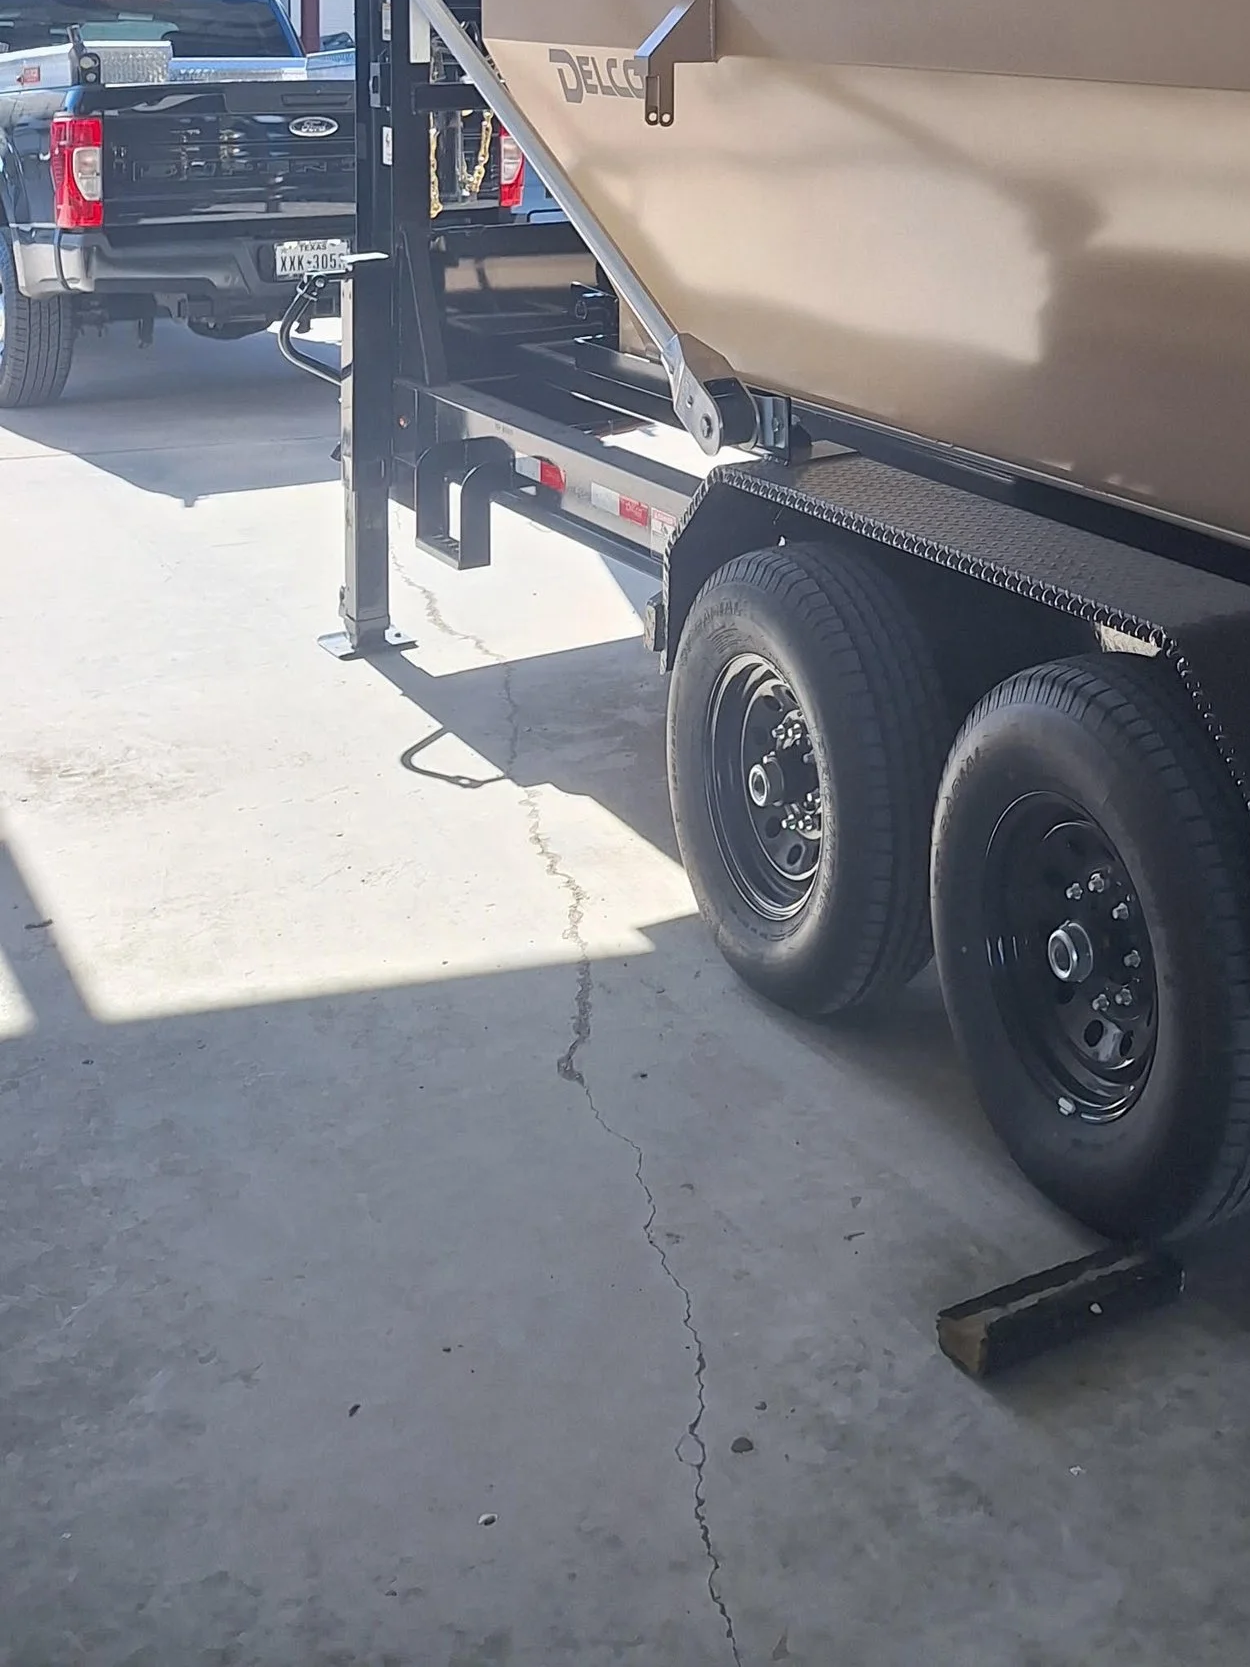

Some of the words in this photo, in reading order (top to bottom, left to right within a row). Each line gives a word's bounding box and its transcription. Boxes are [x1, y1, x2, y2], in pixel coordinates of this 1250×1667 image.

[549, 48, 645, 104] DELCO
[301, 119, 327, 133] Ford
[299, 243, 327, 252] TEXAS
